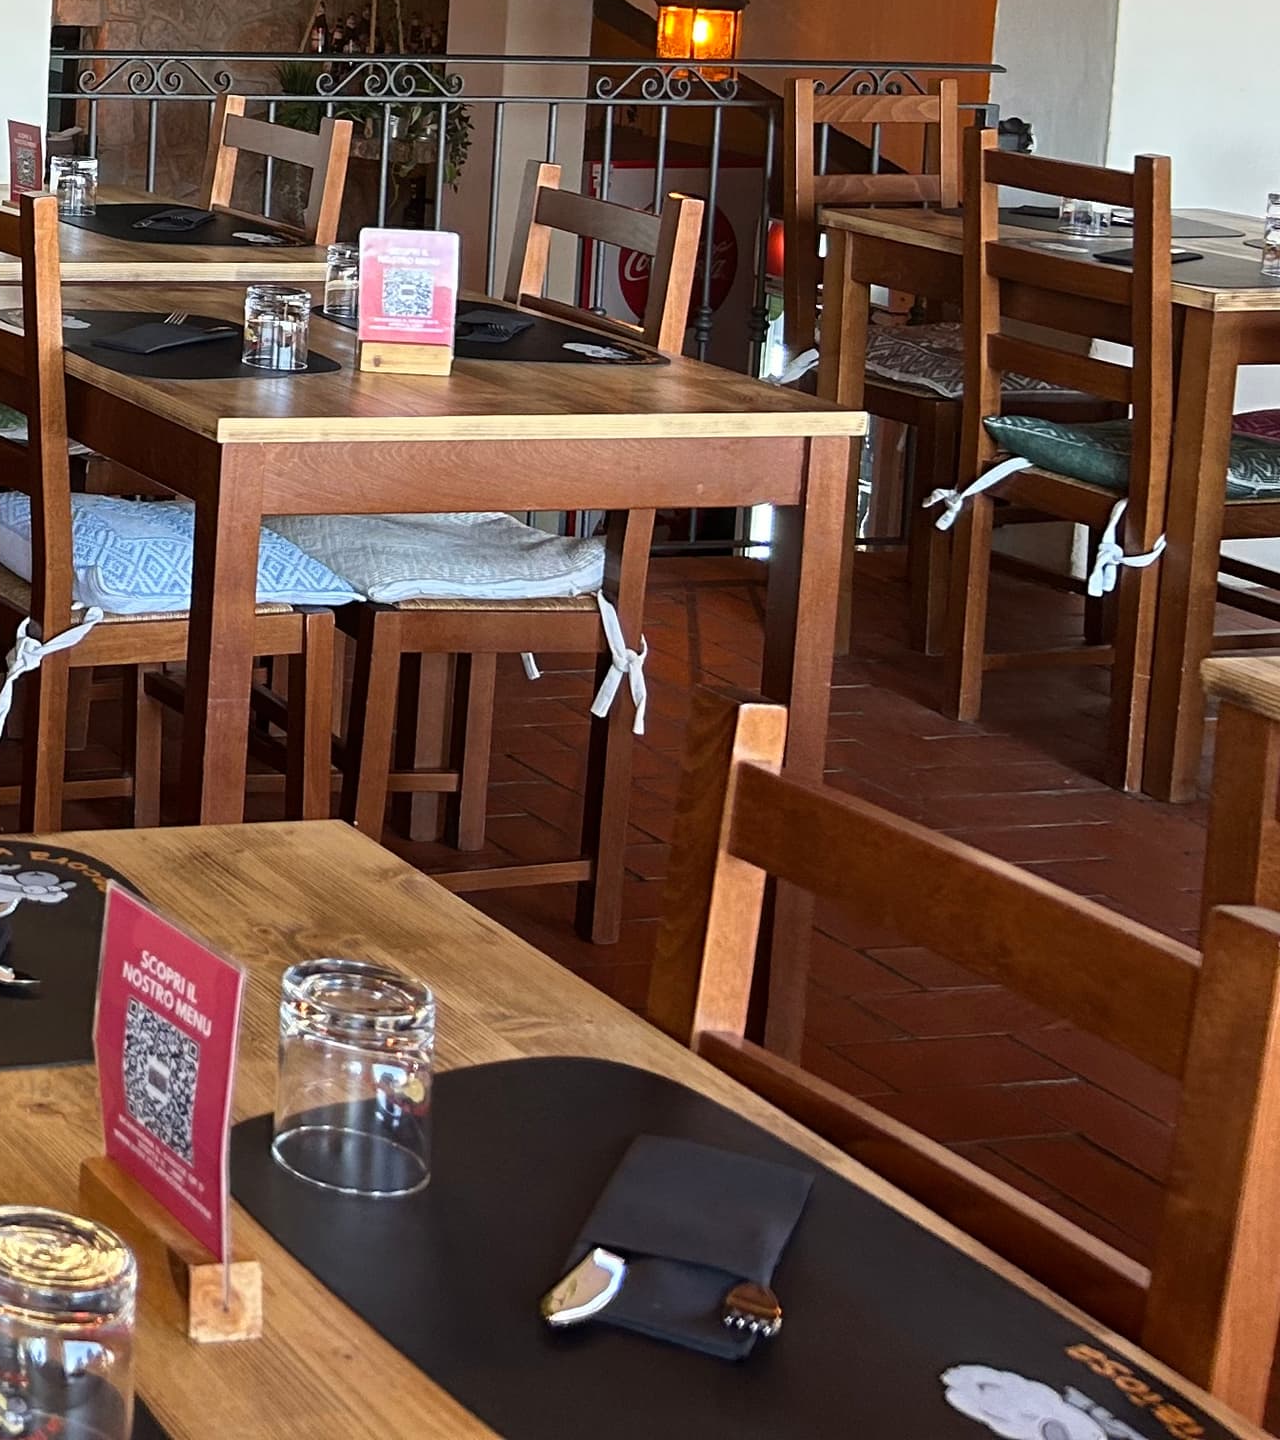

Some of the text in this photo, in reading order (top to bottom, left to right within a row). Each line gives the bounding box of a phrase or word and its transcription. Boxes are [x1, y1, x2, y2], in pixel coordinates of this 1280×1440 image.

[122, 961, 212, 1038] NOSTRO MENU
[141, 950, 198, 1004] SCOPRI IL
